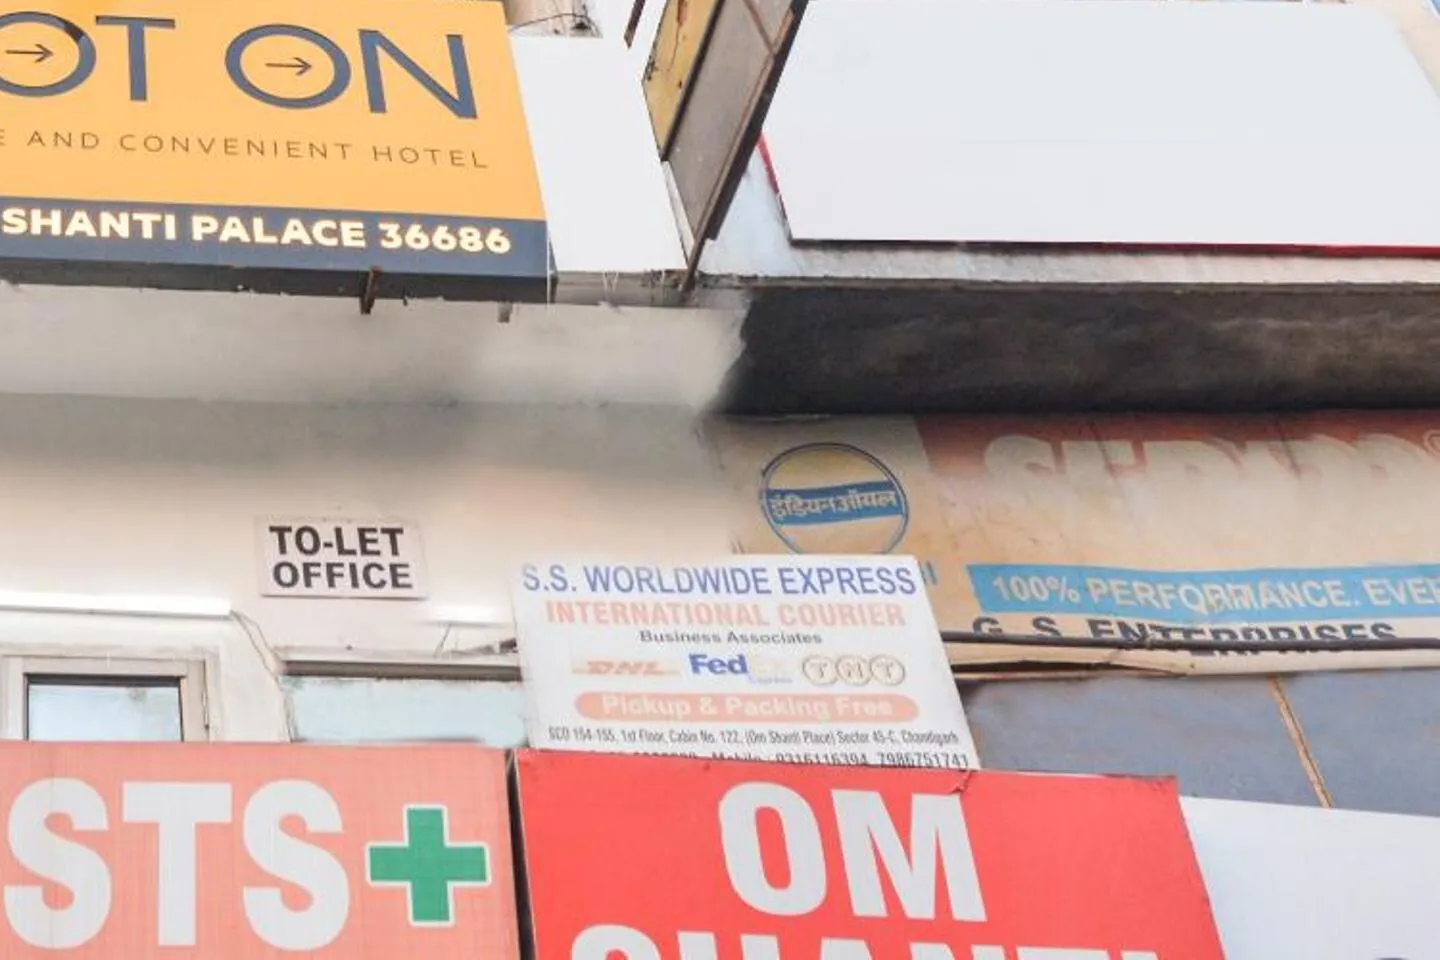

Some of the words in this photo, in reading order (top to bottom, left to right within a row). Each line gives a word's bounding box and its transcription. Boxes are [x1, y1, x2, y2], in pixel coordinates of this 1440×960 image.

[224, 23, 478, 120] ON
[26, 130, 101, 151] AND
[118, 133, 353, 162] CONVENIENT
[372, 145, 490, 169] HOTEL
[1, 206, 176, 241] SHANTI
[191, 214, 367, 248] PALACE
[379, 222, 511, 254] 36686
[269, 525, 404, 557] TO-LET
[272, 561, 413, 589] OFFICE
[521, 563, 577, 593] S.S.
[584, 565, 772, 595] WORLDWIDE
[778, 566, 917, 595] EXPRESS
[992, 574, 1081, 604] 100%
[546, 600, 770, 628] INTERNATIONAL
[777, 602, 906, 628] COURIER
[640, 630, 723, 644] Business
[726, 631, 823, 645] Associates
[600, 694, 690, 719] Pickup
[700, 696, 717, 716] &
[725, 696, 830, 722] Packing
[836, 698, 894, 716] Free
[717, 780, 987, 924] OM
